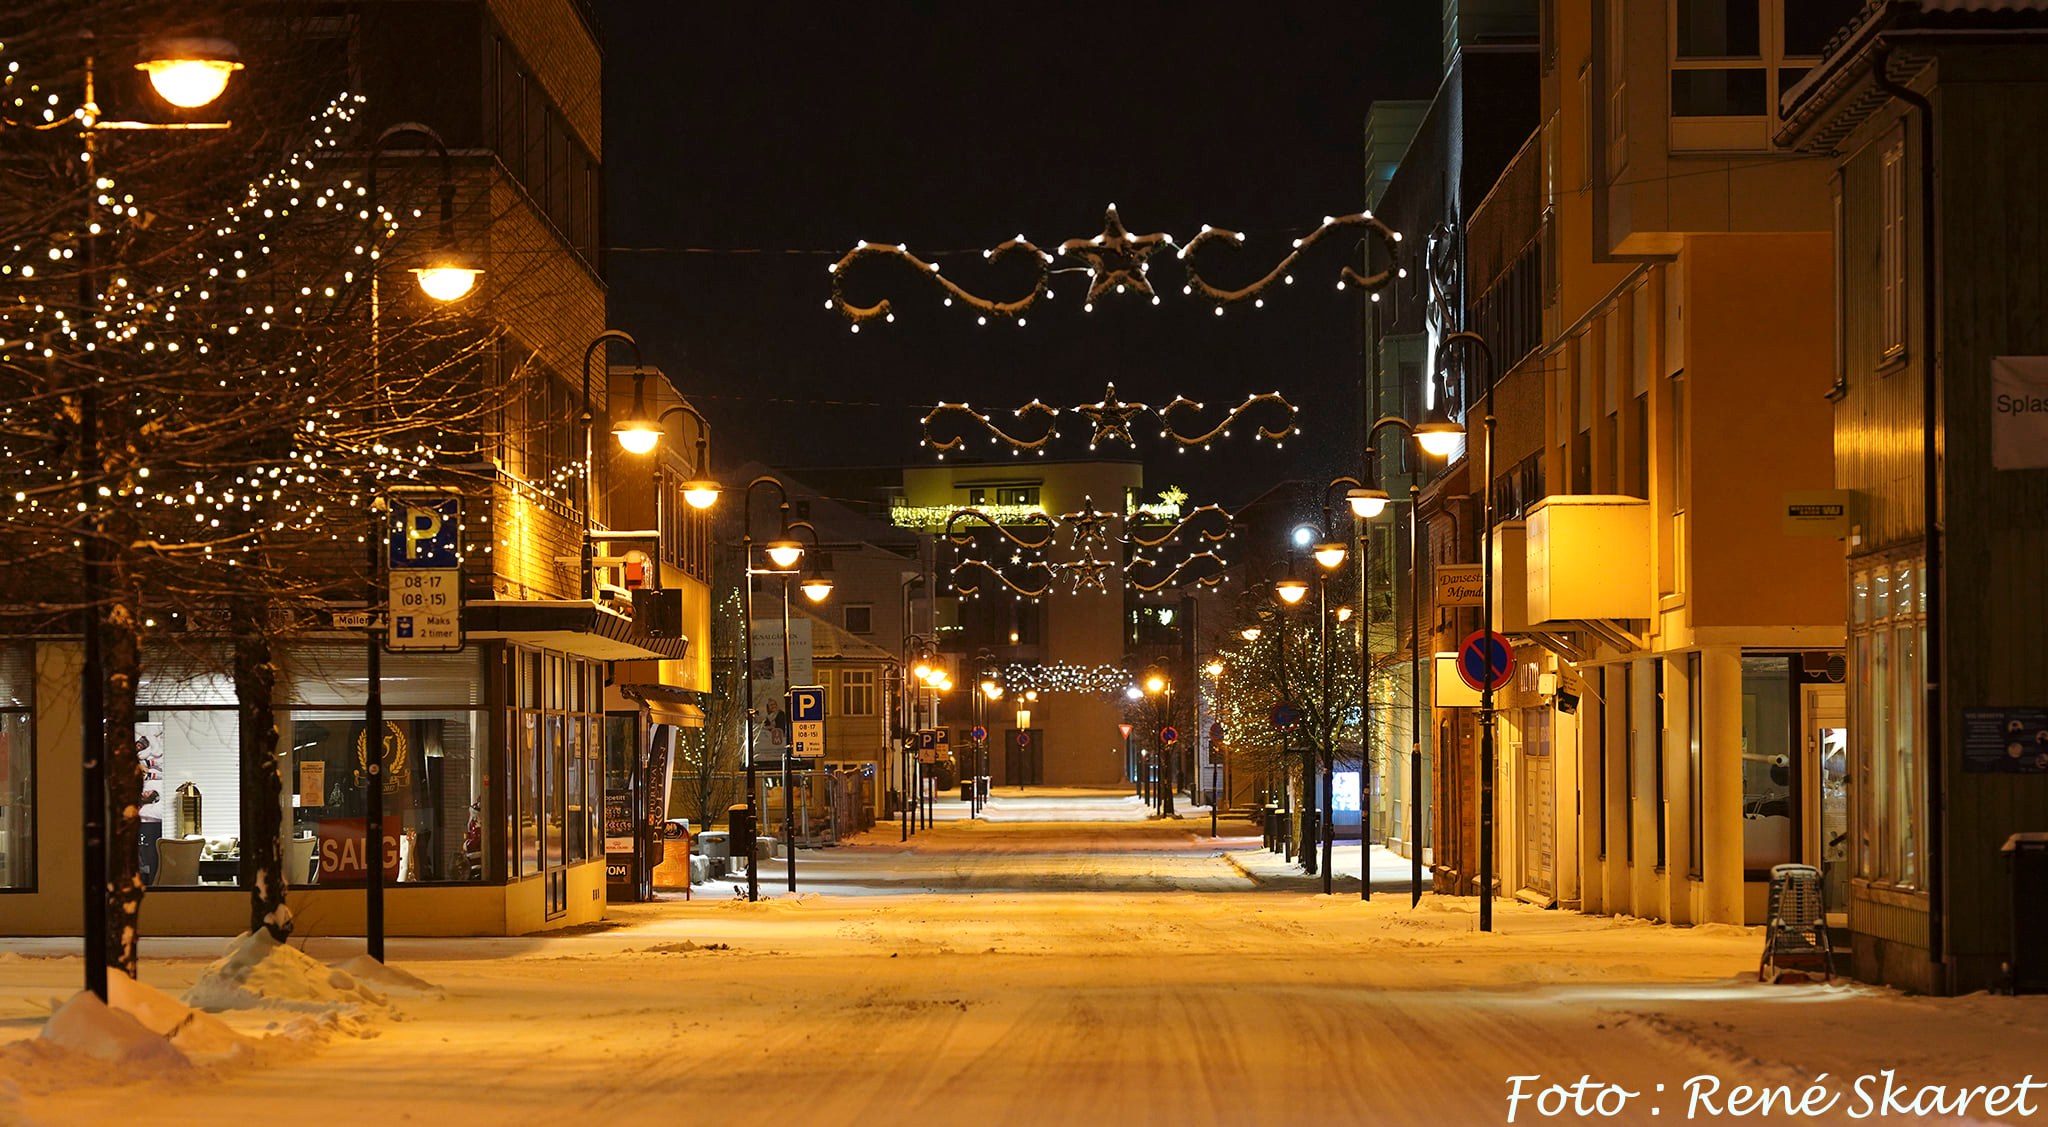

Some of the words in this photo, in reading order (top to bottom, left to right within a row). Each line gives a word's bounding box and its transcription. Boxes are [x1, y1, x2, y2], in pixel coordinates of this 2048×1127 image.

[406, 506, 442, 560] P
[404, 576, 442, 588] 08-17
[402, 592, 447, 606] (08-15)
[1447, 585, 1484, 602] Mjønd
[427, 617, 451, 625] Maks
[420, 629, 427, 637] 2
[429, 628, 453, 637] timer
[799, 694, 816, 718] P
[923, 735, 932, 748] P
[937, 731, 945, 743] P
[649, 767, 657, 813] PURINA
